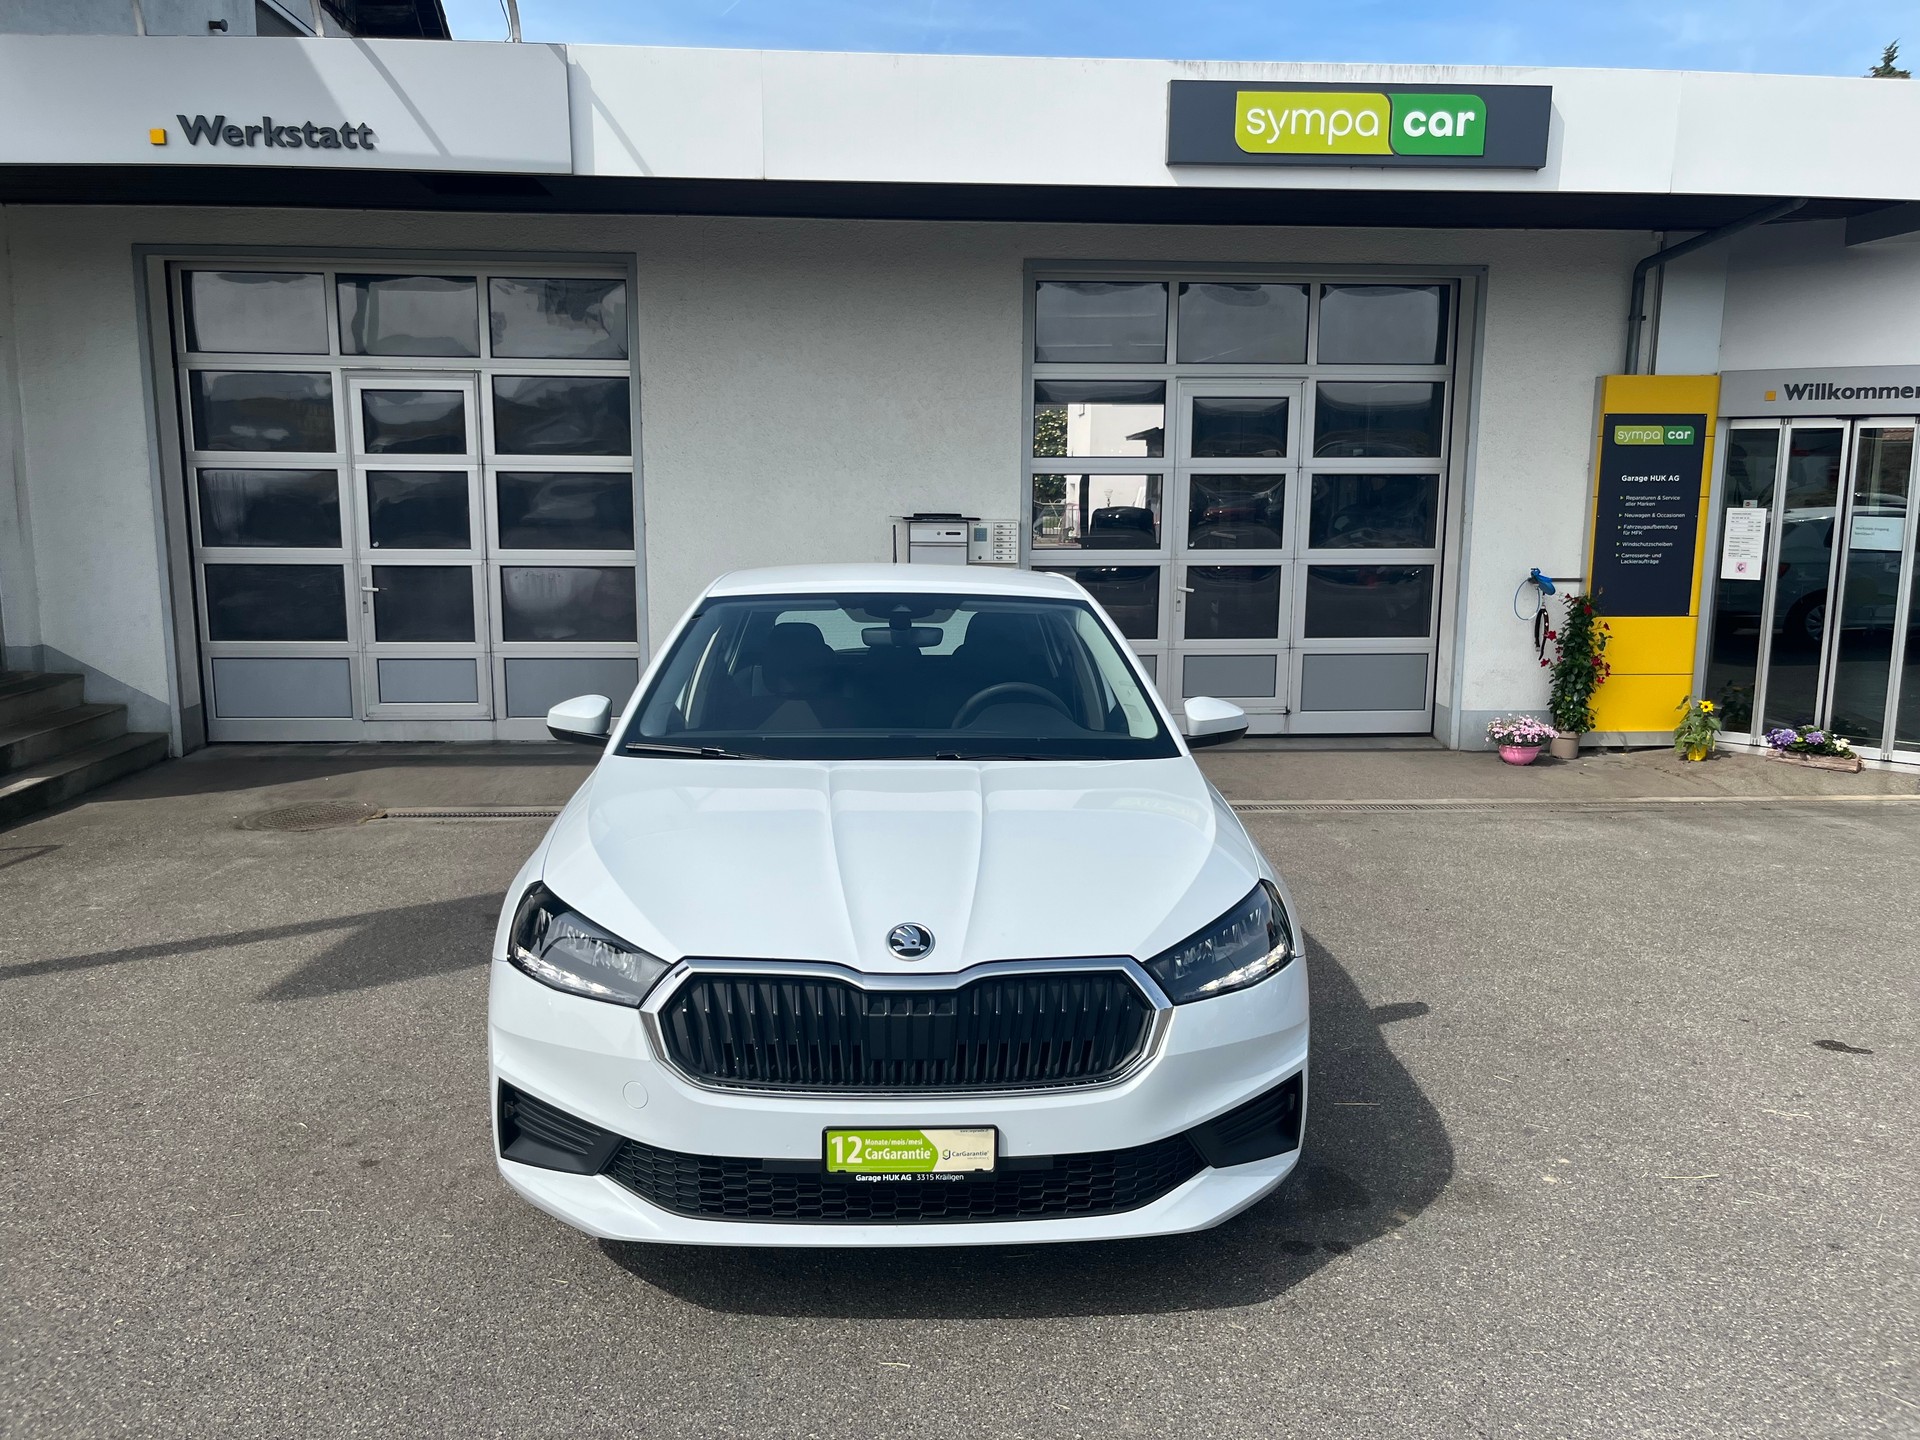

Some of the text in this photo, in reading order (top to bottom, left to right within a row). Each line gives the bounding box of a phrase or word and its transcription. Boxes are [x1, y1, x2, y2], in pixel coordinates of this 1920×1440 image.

[176, 114, 376, 150] Werkstatt
[1245, 107, 1476, 146] sympa car
[1617, 429, 1691, 443] sympa car
[1621, 475, 1648, 483] Garage
[831, 1135, 863, 1164] 12
[855, 1174, 882, 1182] Garage
